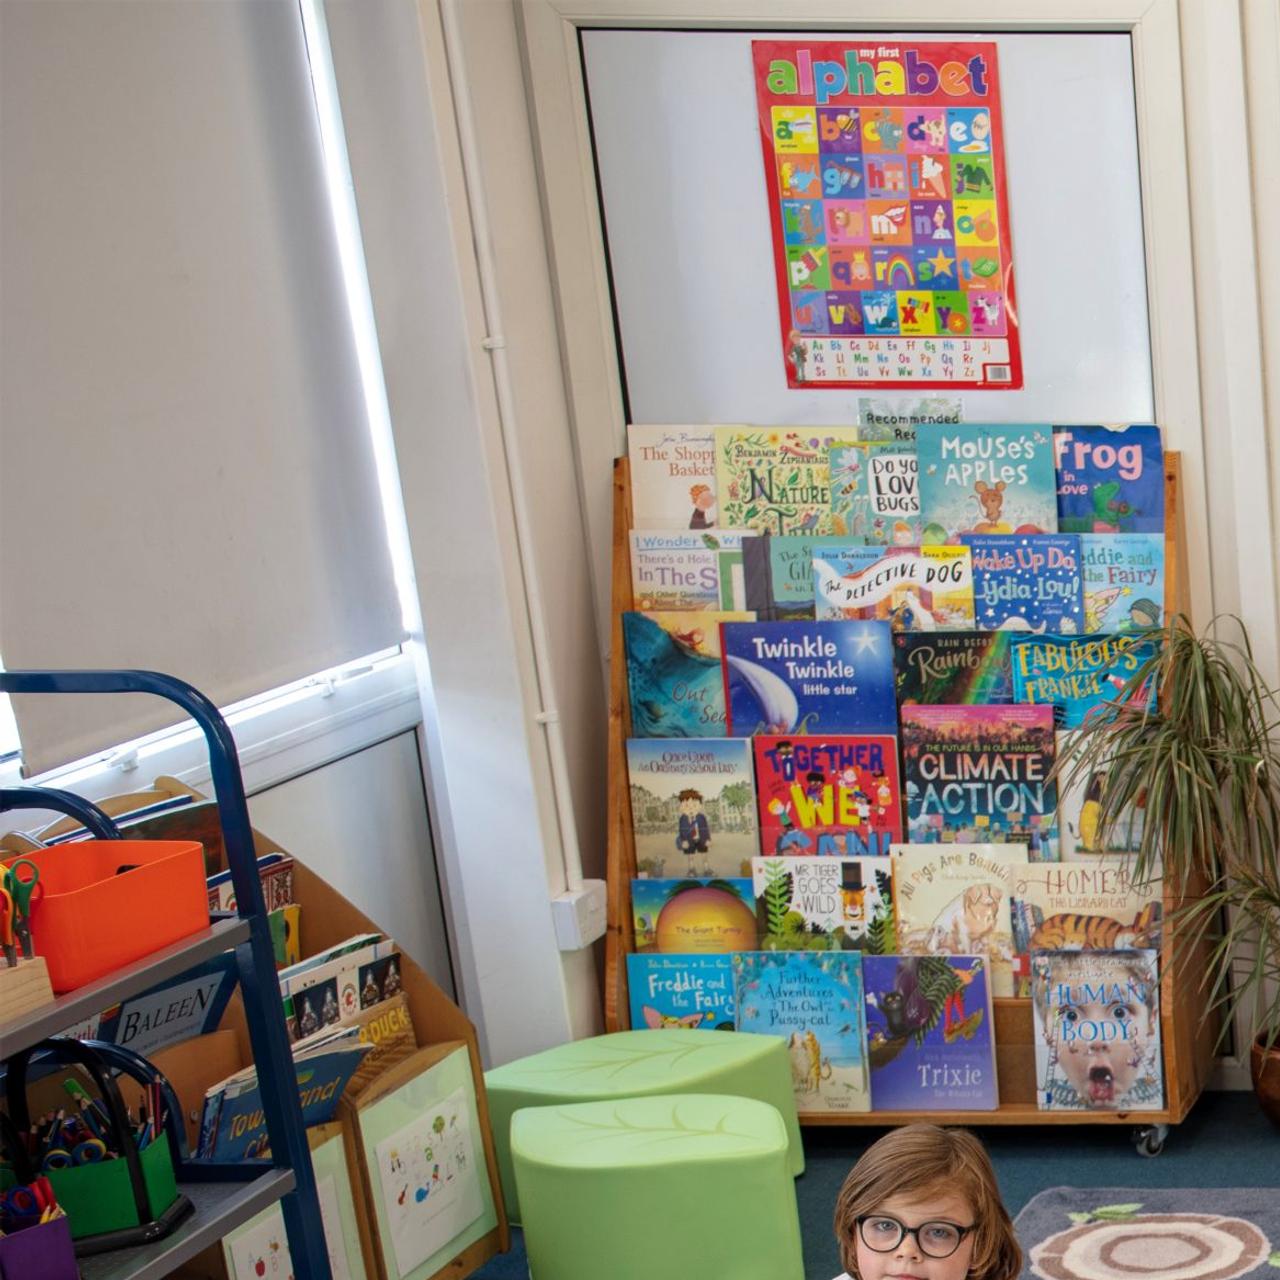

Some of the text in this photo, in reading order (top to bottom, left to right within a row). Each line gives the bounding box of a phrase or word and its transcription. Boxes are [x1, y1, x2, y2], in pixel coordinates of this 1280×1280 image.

[860, 46, 900, 59] my first
[767, 49, 988, 104] alphabet
[867, 414, 960, 425] Recommended
[640, 446, 668, 460] The
[1053, 432, 1142, 480] Frog
[669, 462, 714, 476] Basket
[872, 458, 918, 474] DO YO
[1064, 470, 1075, 482] in
[742, 466, 829, 504] NATURE
[875, 475, 916, 495] LOV
[644, 536, 698, 547] Wonder
[973, 548, 1016, 570] Wake
[1017, 548, 1044, 574] Up
[1083, 549, 1125, 567] eddie
[638, 565, 696, 586] In The
[825, 580, 842, 593] The
[846, 563, 917, 601] DETECTIVE
[926, 561, 963, 584] DOG
[1108, 566, 1157, 585] Fairy
[1037, 577, 1079, 601] Lou!
[753, 634, 837, 658] Twinkle
[786, 659, 855, 679] Twinkle
[673, 683, 706, 702] Out
[804, 683, 858, 695] little star
[764, 743, 885, 781] TOGETHER
[919, 753, 1044, 780] CLIMATE
[790, 782, 861, 828] WE
[919, 783, 1044, 815] ACTION
[795, 864, 839, 877] MR TIGER
[940, 854, 962, 869] Are
[969, 852, 1010, 882] Beauti
[799, 877, 837, 895] GOES
[1046, 868, 1140, 896] HOMER
[801, 895, 836, 914] WILD
[648, 973, 726, 997] Freddie and
[778, 970, 821, 984] Further
[766, 983, 835, 1000] Adventures
[1047, 982, 1145, 1005] HUMAN
[120, 983, 216, 1045] BALEEN
[672, 992, 735, 1015] the Fairy
[778, 1000, 823, 1012] The Owl
[769, 1009, 832, 1031] Pussy-cat
[1061, 1019, 1133, 1042] BODY
[917, 1063, 982, 1088] Trixie
[229, 1109, 265, 1140] Tow
